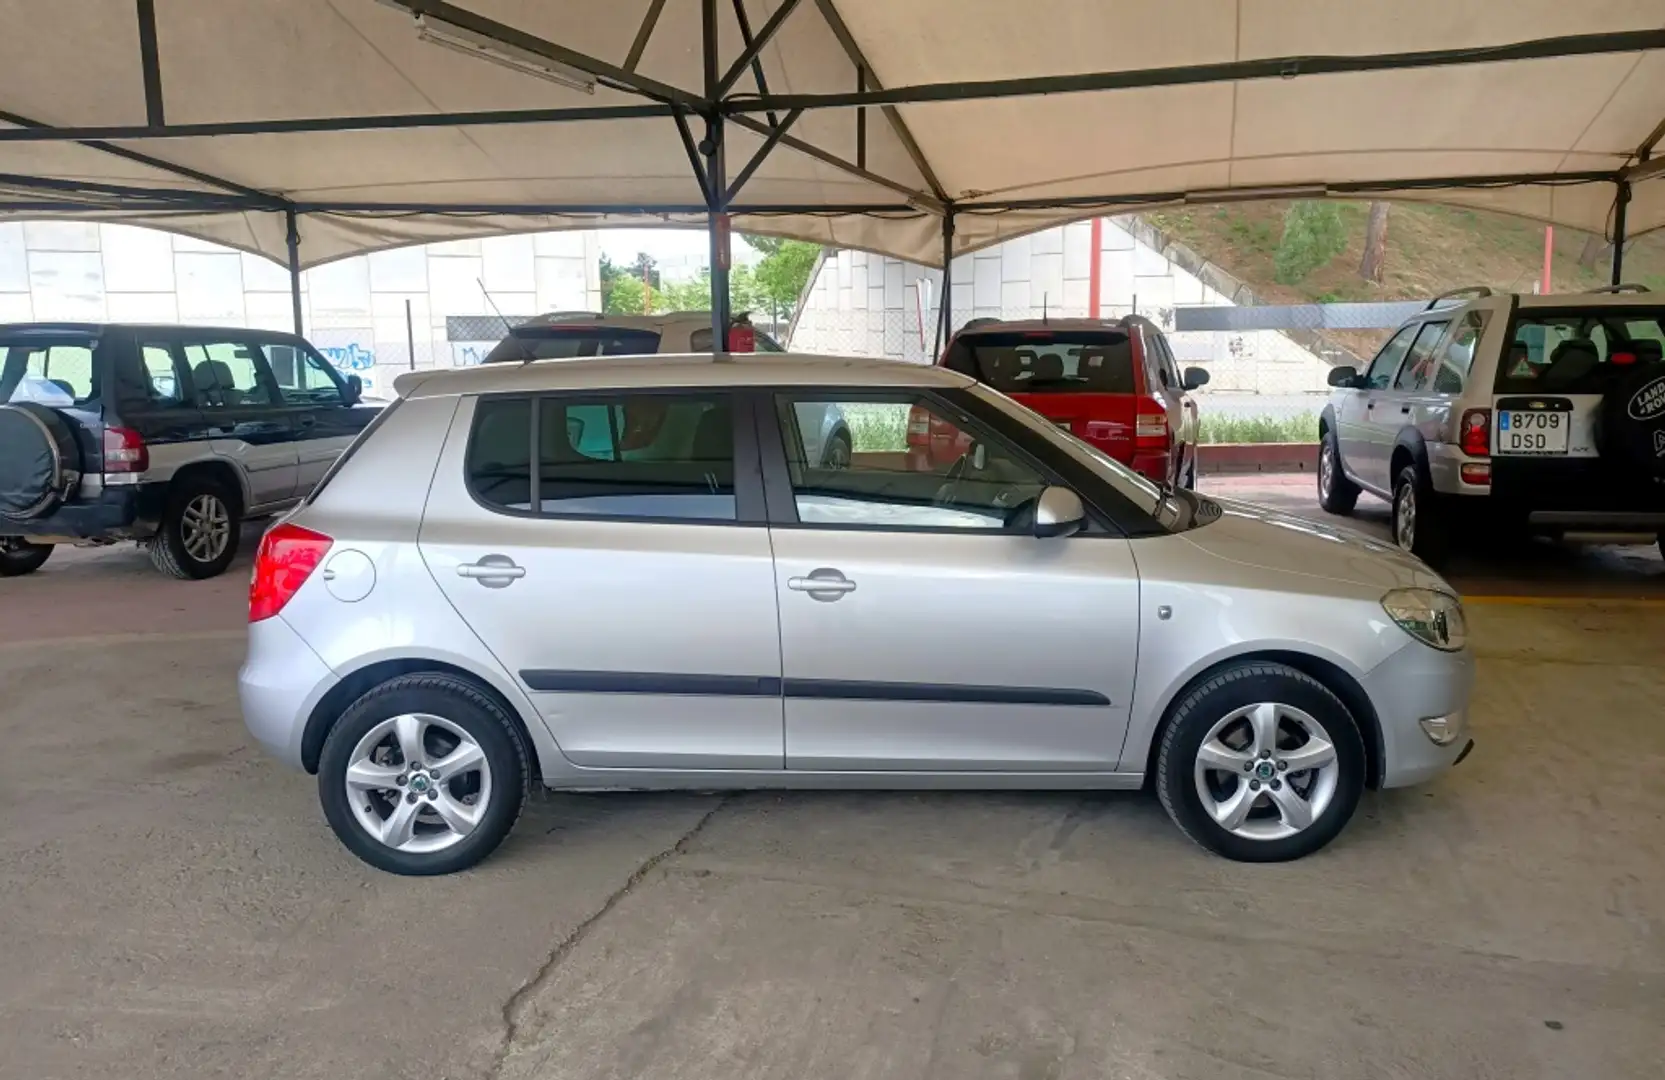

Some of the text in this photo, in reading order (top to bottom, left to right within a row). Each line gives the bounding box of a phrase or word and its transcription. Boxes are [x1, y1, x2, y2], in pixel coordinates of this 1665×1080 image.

[1637, 382, 1665, 407] LAND
[1512, 413, 1559, 429] 8709
[1511, 433, 1546, 449] DSD
